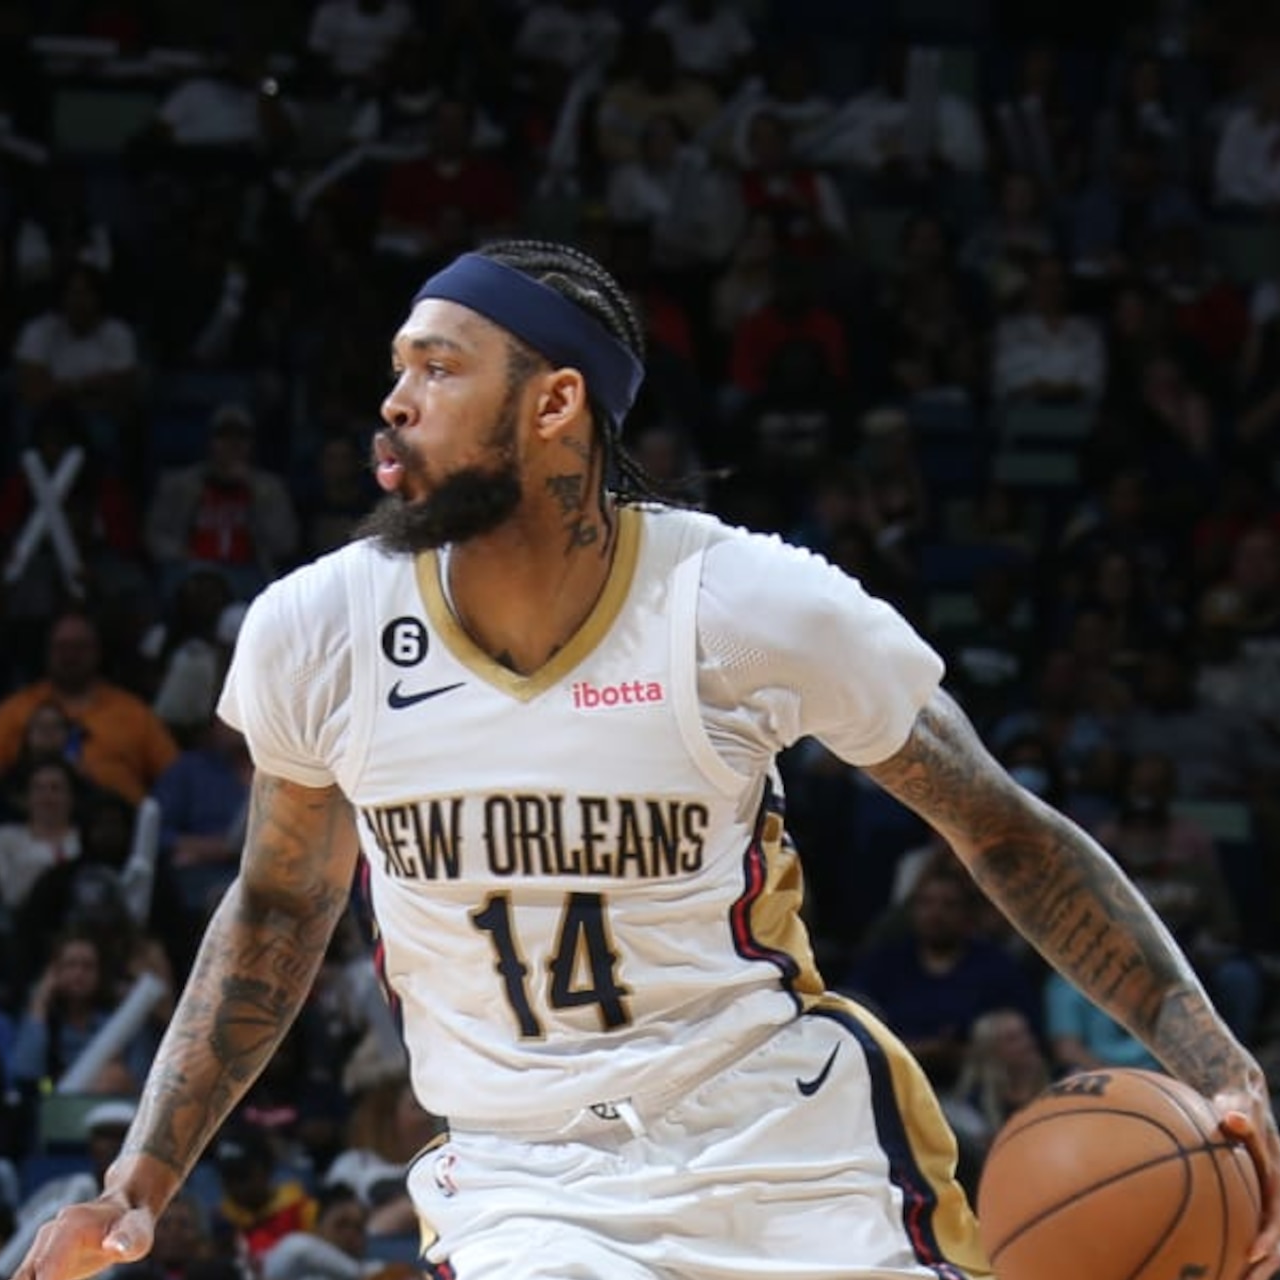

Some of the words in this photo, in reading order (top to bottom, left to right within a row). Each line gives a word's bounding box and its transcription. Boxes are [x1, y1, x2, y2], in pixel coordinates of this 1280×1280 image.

[392, 620, 422, 667] 6
[572, 681, 663, 709] ibotta
[362, 797, 464, 880] NEW
[483, 794, 710, 878] ORLEANS
[468, 889, 635, 1041] 14
